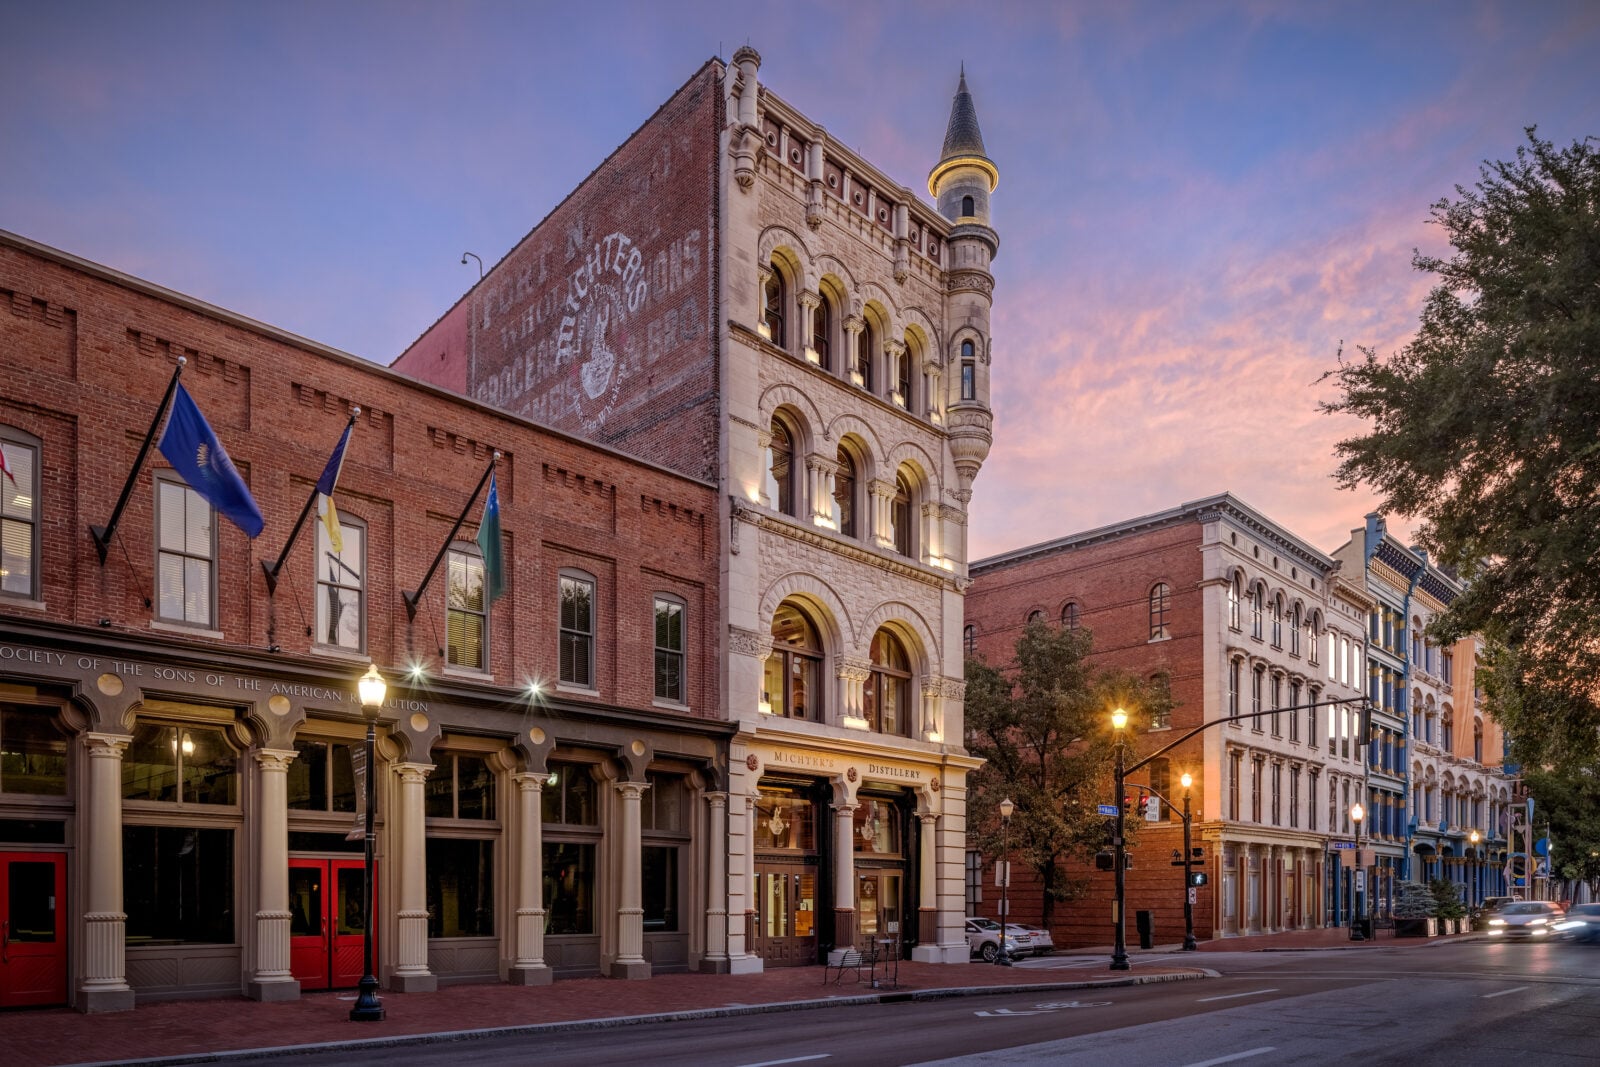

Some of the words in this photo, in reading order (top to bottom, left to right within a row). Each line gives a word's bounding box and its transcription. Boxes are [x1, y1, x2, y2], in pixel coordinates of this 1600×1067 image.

[77, 657, 101, 670] OF
[112, 661, 143, 676] THE
[154, 667, 196, 683] SONS
[206, 674, 225, 687] OF
[235, 677, 261, 691] THE
[270, 683, 342, 701] AMERICAN
[774, 751, 835, 768] MICHTER'S
[869, 763, 921, 779] DISTILLERY
